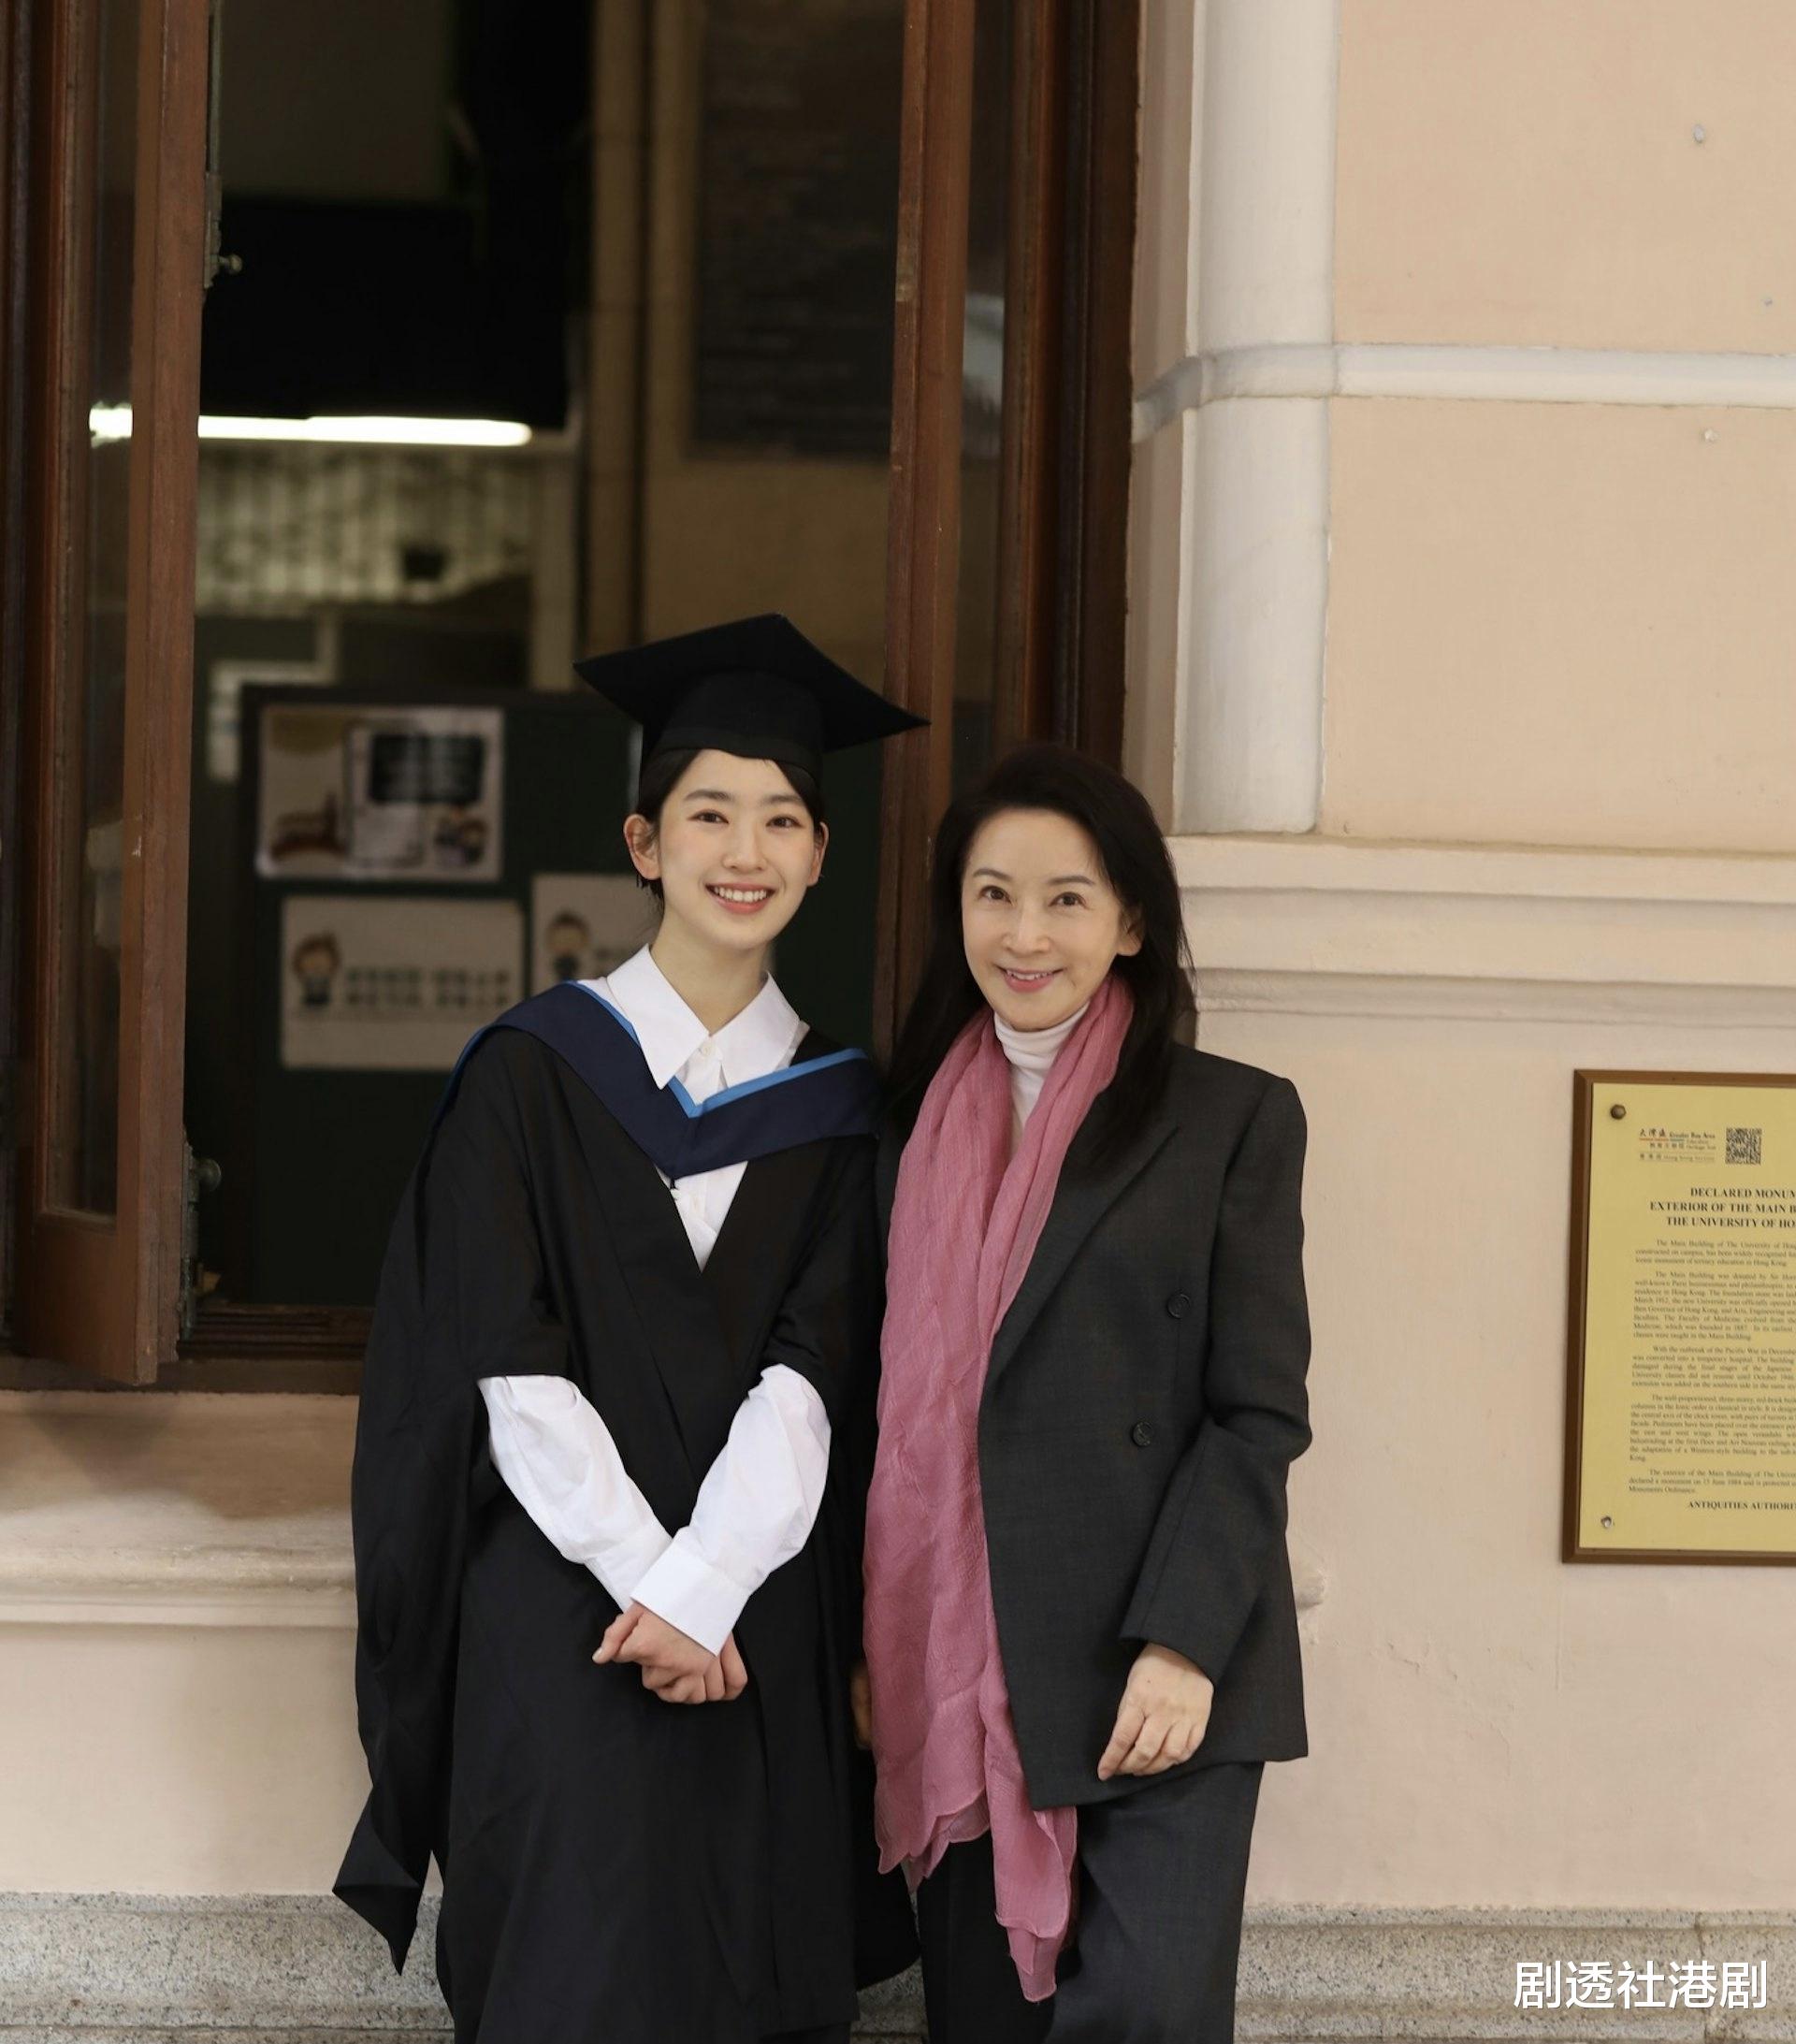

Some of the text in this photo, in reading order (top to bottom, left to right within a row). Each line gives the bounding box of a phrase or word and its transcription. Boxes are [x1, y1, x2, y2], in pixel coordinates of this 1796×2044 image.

[1690, 1187, 1752, 1198] DECLARED
[1650, 1201, 1708, 1212] EXTERIOR
[1710, 1202, 1726, 1212] OF
[1729, 1203, 1753, 1213] THE
[1755, 1203, 1786, 1213] MAIN
[1667, 1216, 1689, 1226] THE
[1691, 1217, 1758, 1227] UNIVERSITY
[1760, 1218, 1777, 1227] OF
[1688, 1500, 1796, 1511] ANTIQUITIES AUTHORI
